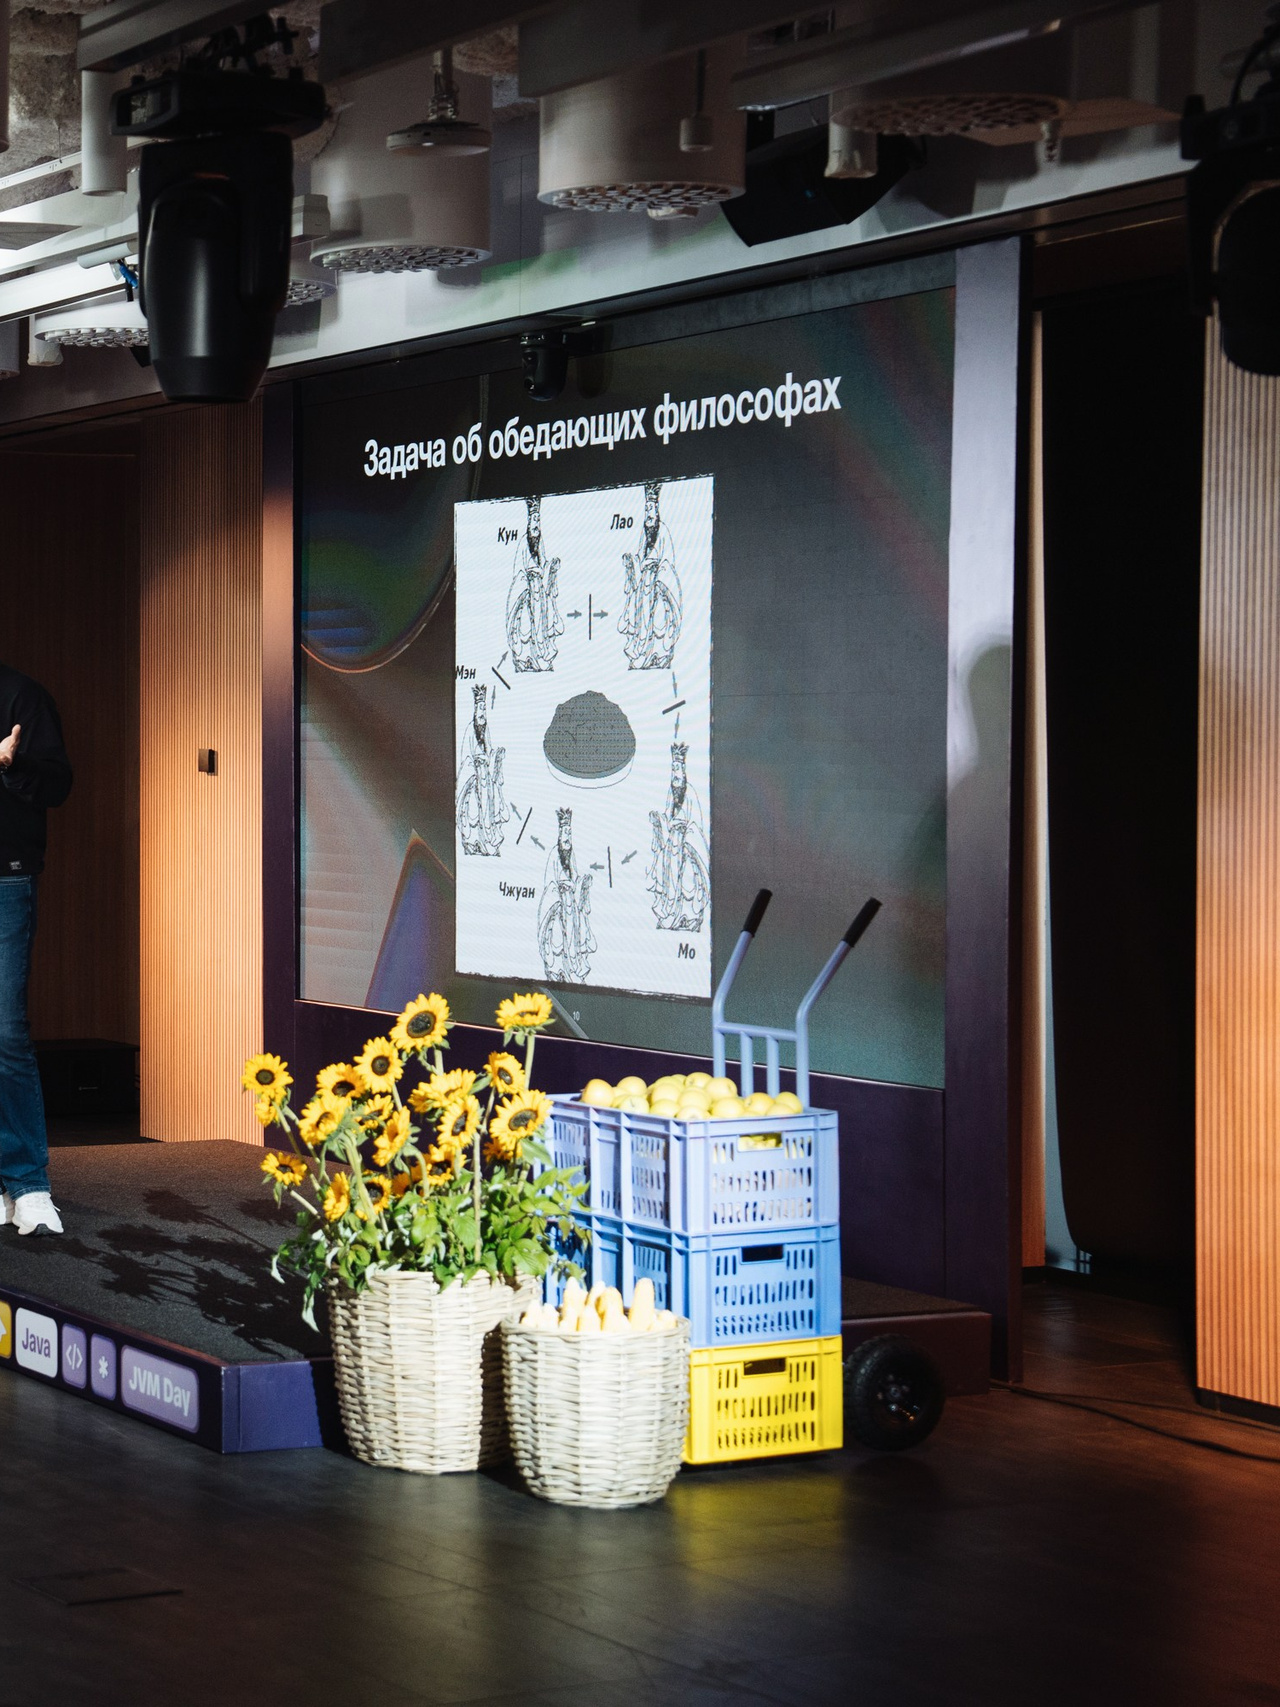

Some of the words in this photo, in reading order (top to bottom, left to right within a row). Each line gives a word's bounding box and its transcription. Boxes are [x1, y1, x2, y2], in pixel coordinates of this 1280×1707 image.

[364, 439, 445, 480] Задача
[453, 423, 482, 464] об
[489, 408, 646, 460] обедающих
[654, 373, 841, 444] философах
[610, 514, 633, 530] Лао
[498, 527, 518, 545] Кун
[455, 664, 477, 680] Мэн
[499, 881, 535, 901] Чжуан
[678, 943, 696, 960] Мо
[572, 1010, 581, 1022] 10
[21, 1327, 51, 1358] Java
[129, 1366, 160, 1400] JVM
[163, 1377, 191, 1416] Day
